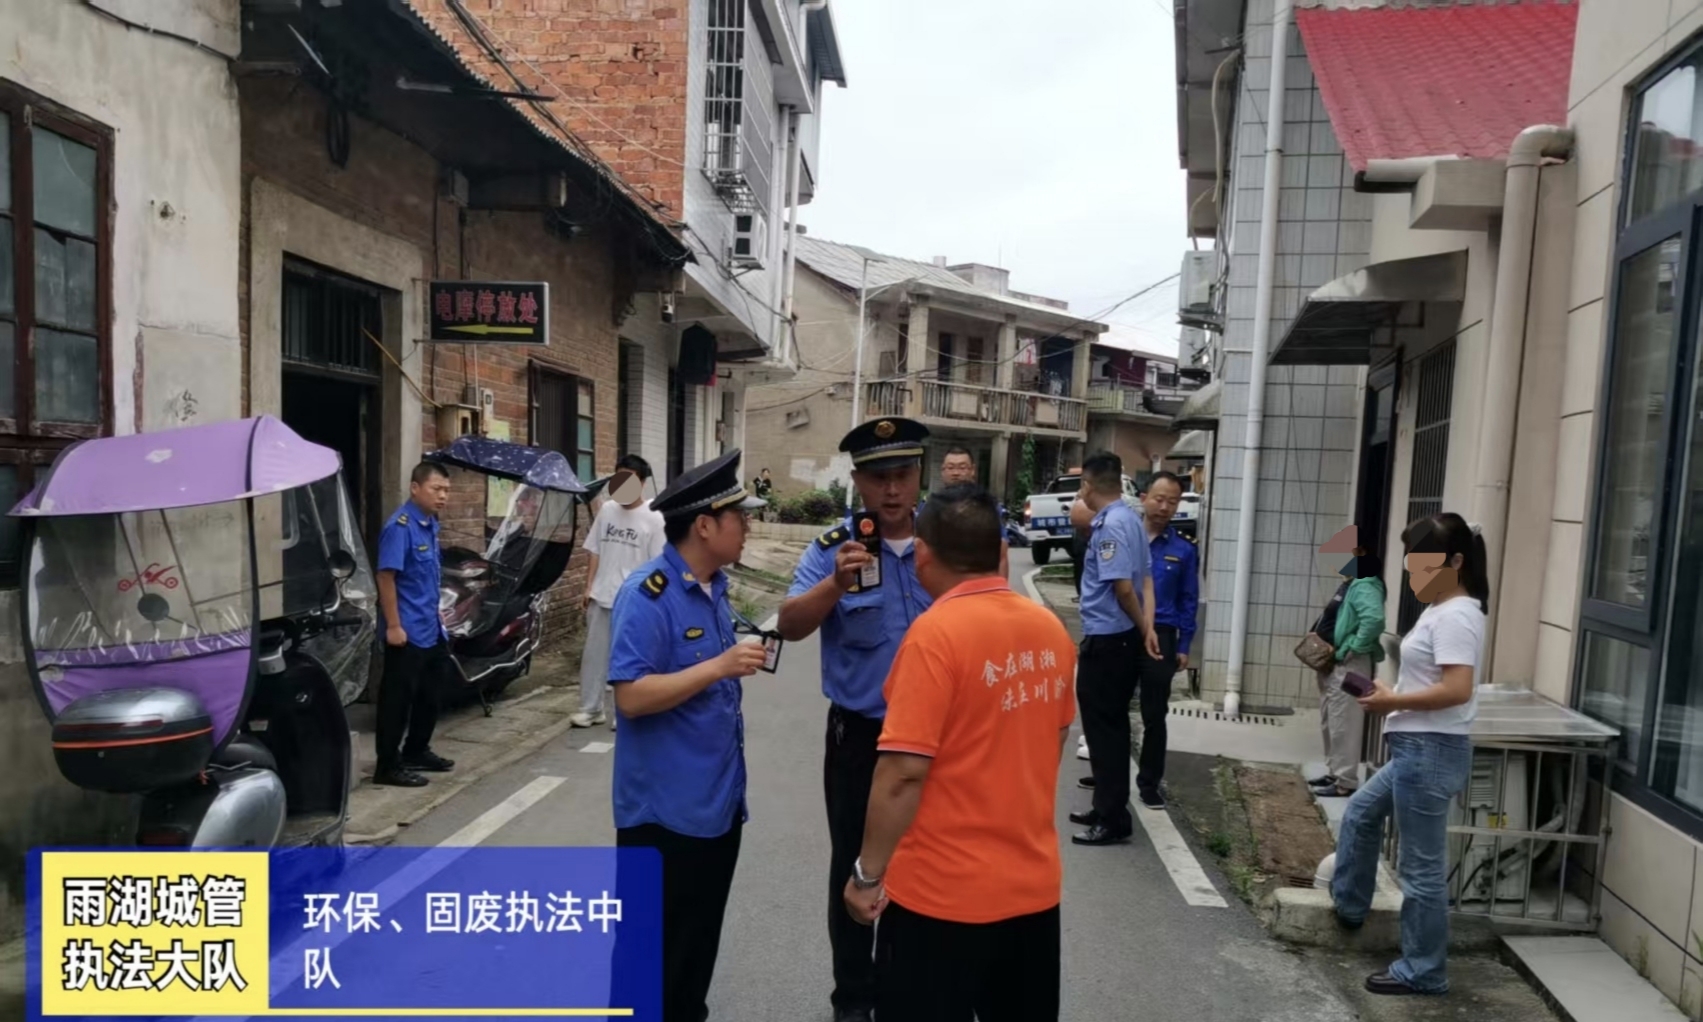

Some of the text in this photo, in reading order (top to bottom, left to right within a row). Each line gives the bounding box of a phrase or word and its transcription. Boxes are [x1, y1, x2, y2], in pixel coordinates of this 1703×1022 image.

[435, 289, 538, 323] 电摩停放处
[1037, 517, 1072, 527] 城市管
